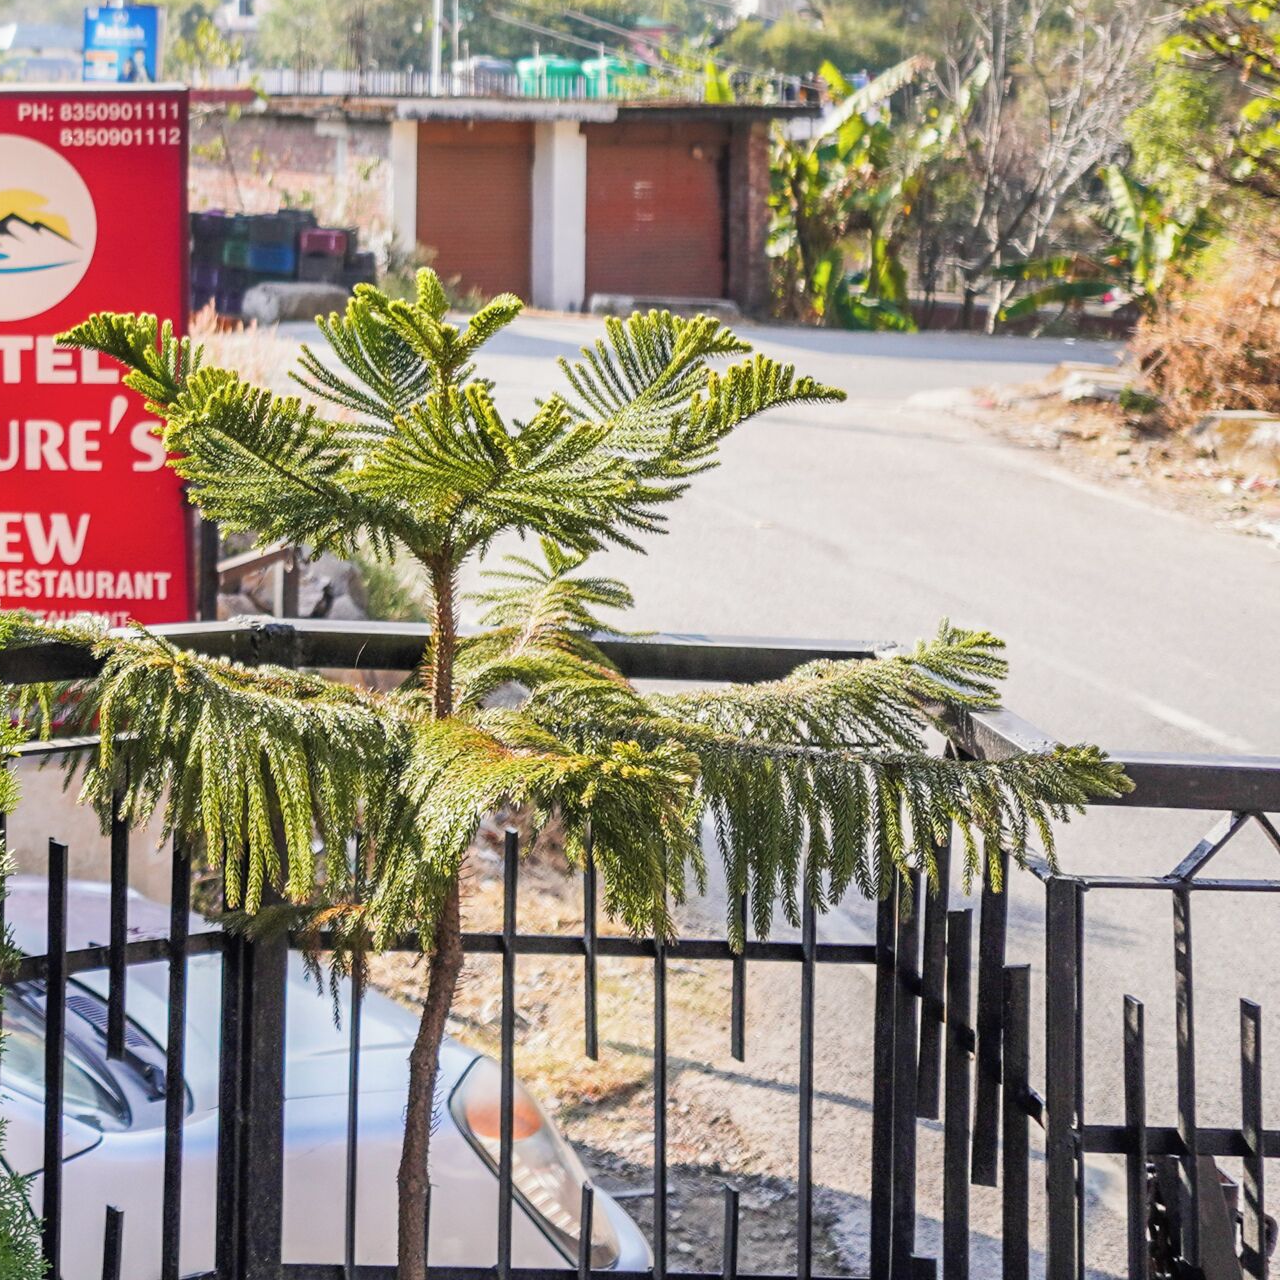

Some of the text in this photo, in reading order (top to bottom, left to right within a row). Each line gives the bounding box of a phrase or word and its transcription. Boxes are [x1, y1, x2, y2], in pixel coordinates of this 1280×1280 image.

[17, 102, 179, 121] PH: 8350901111
[60, 128, 181, 146] 8350901112
